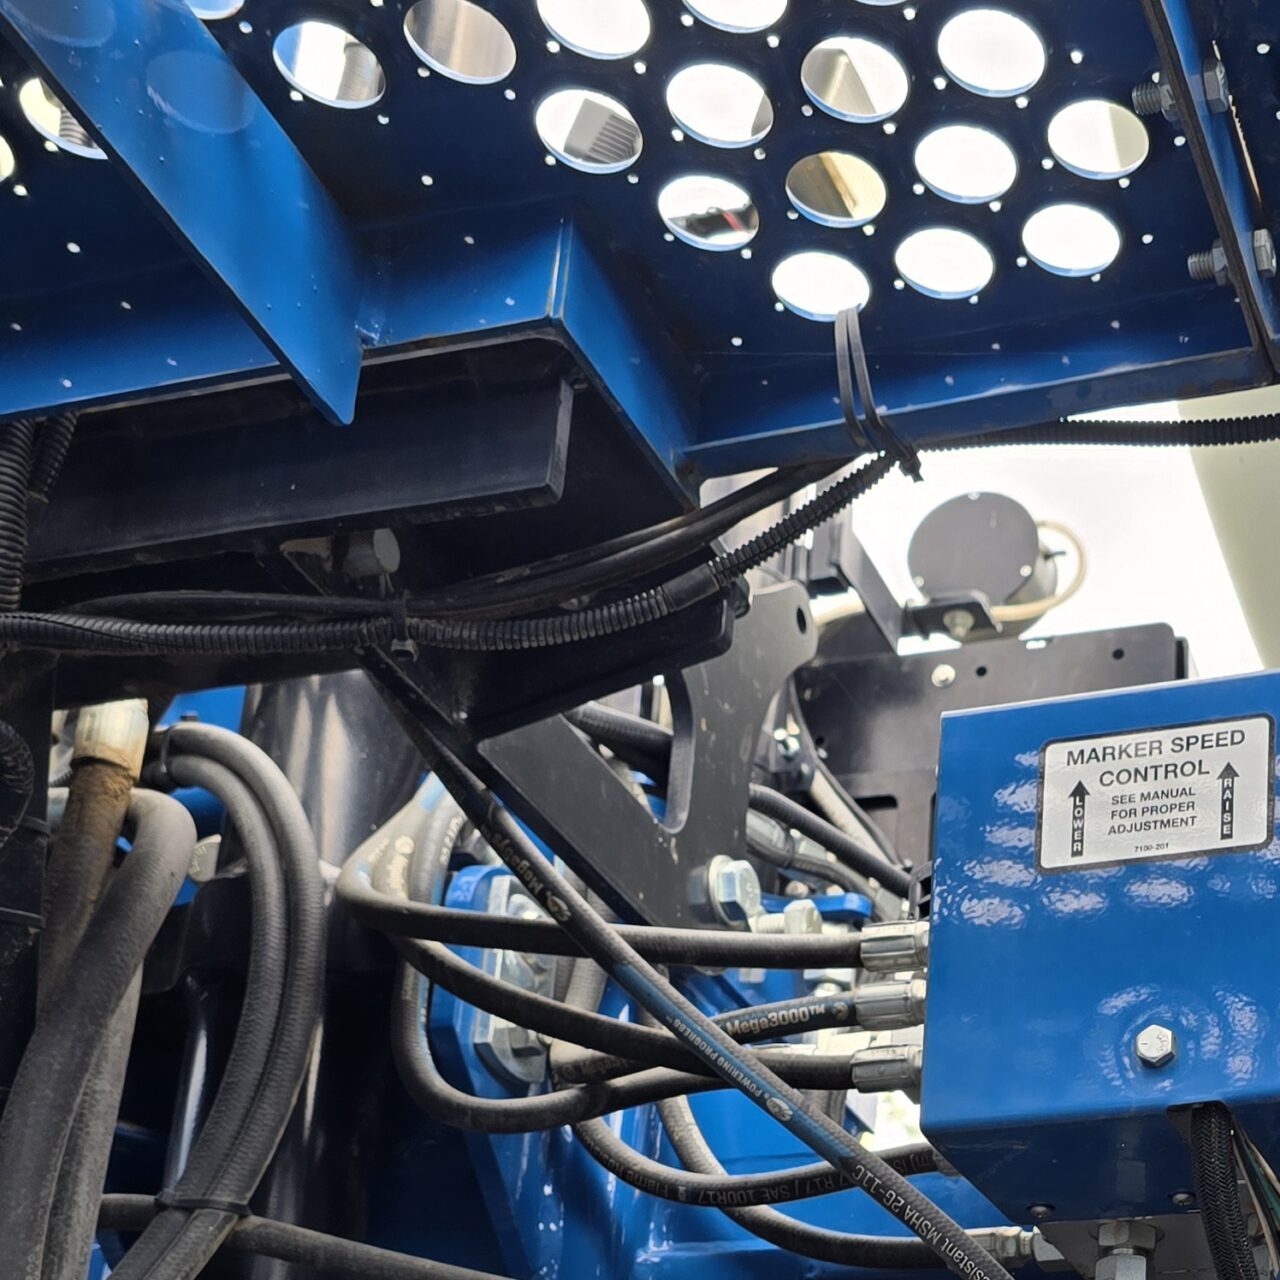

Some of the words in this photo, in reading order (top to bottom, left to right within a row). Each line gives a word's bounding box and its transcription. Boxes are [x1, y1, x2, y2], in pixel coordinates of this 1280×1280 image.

[1066, 740, 1162, 766] MARKER
[1170, 729, 1246, 754] SPEED
[1099, 759, 1210, 787] CONTROL
[1110, 809, 1137, 821] FOR
[1142, 801, 1196, 816] PROPER
[1111, 794, 1136, 806] SEE
[1140, 786, 1196, 802] MANUAL
[1222, 778, 1232, 835] RAISE
[1072, 796, 1084, 853] LOWER
[1107, 816, 1198, 836] ADJUSTMENT
[852, 1164, 905, 1213] 2G-11C
[904, 1205, 942, 1244] MSHA
